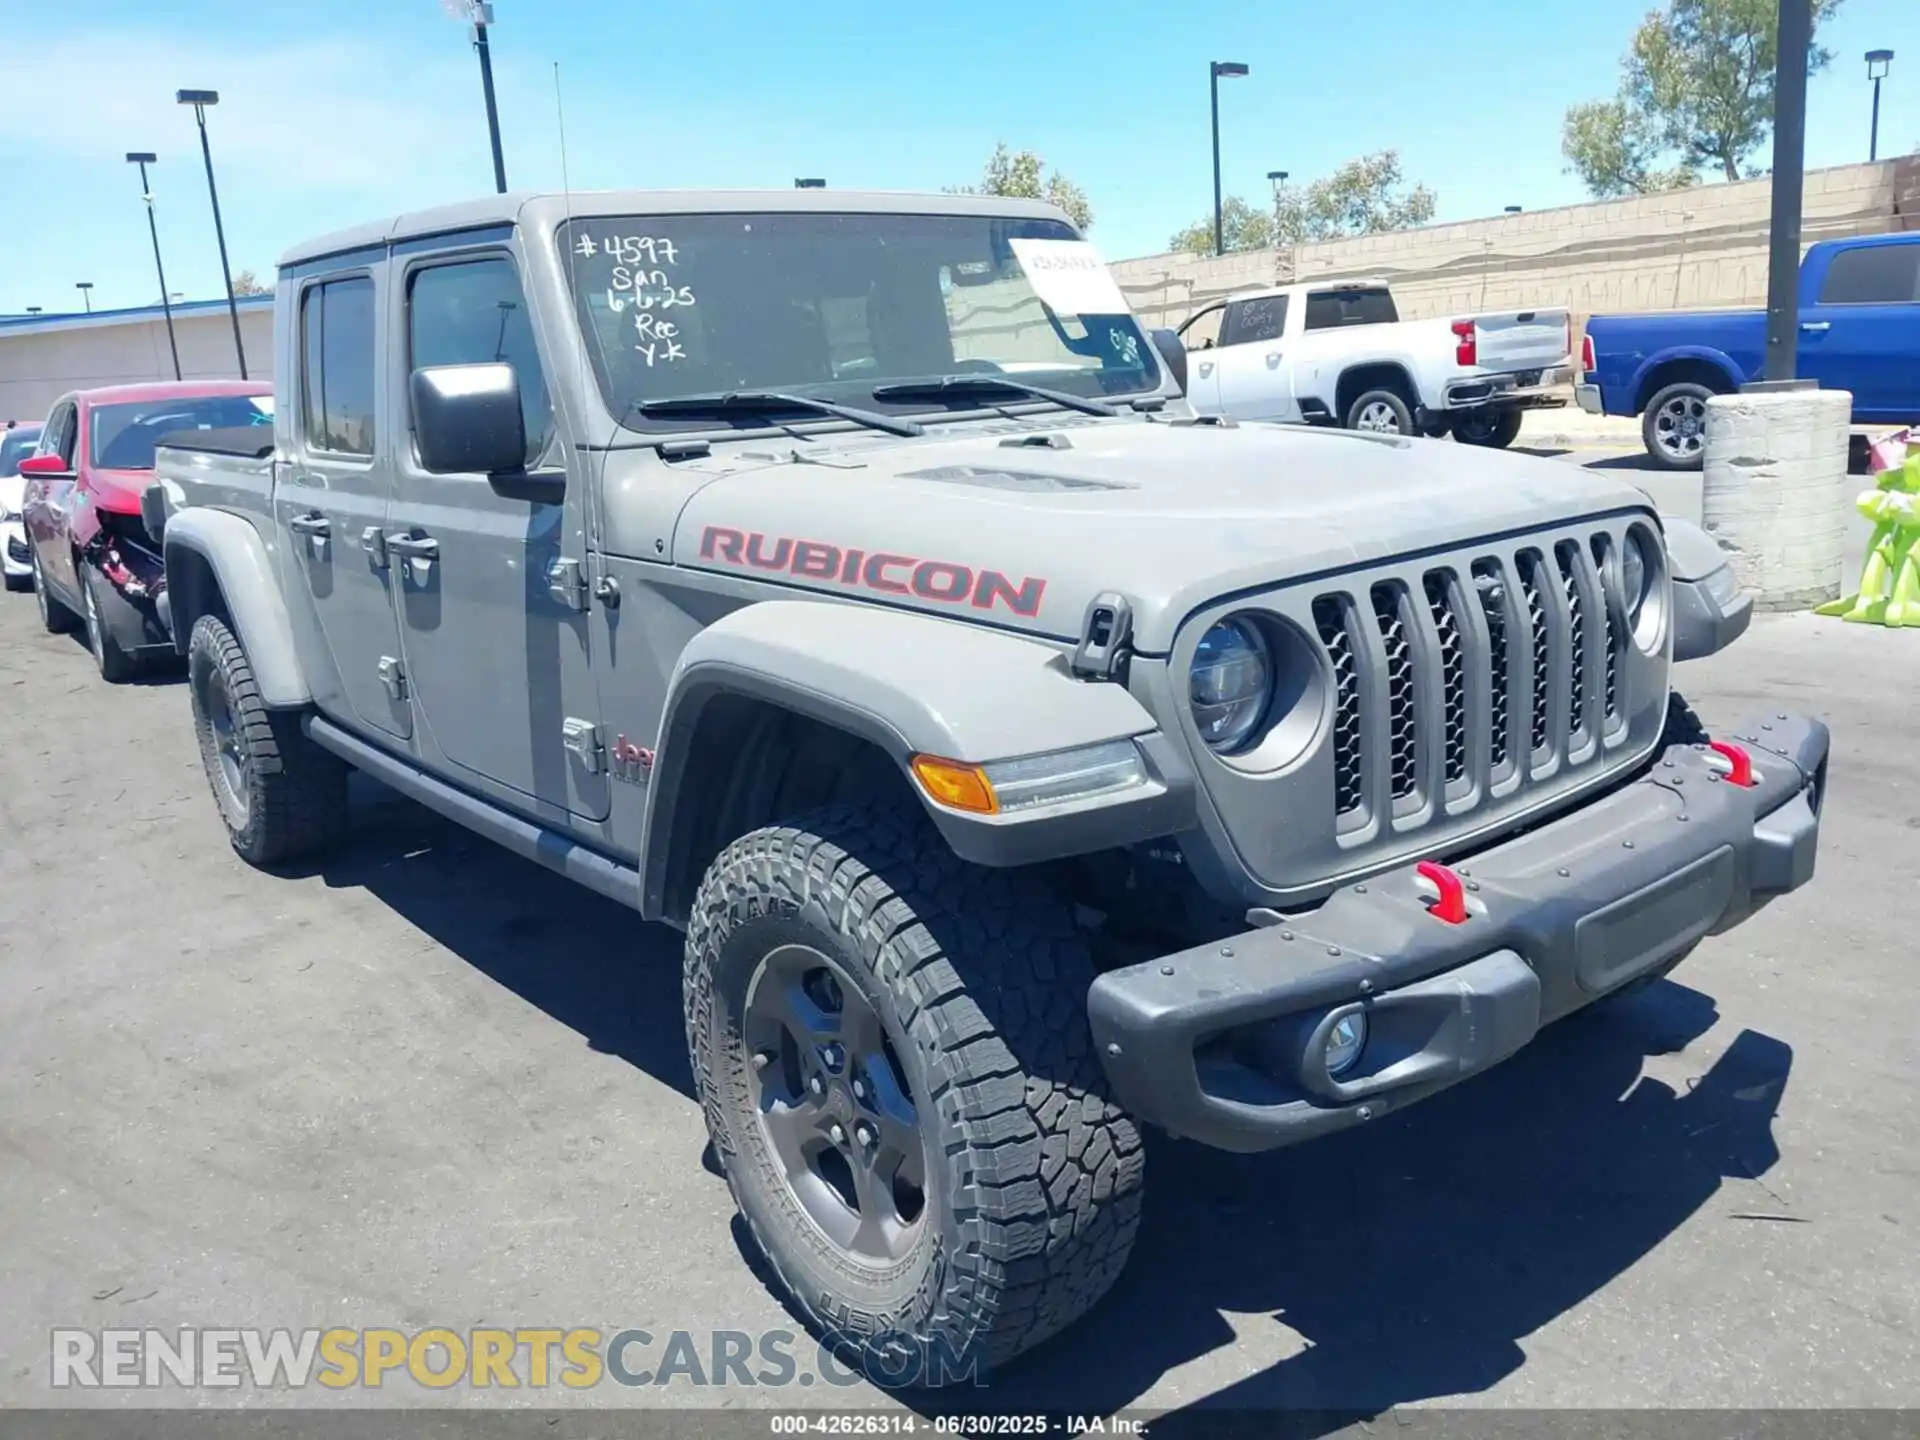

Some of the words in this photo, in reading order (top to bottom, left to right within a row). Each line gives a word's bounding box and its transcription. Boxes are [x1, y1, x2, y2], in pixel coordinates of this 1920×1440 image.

[612, 266, 668, 290] San
[607, 286, 696, 312] 6-6-25
[699, 525, 1048, 618] RUBICON
[611, 733, 656, 766] Jee
